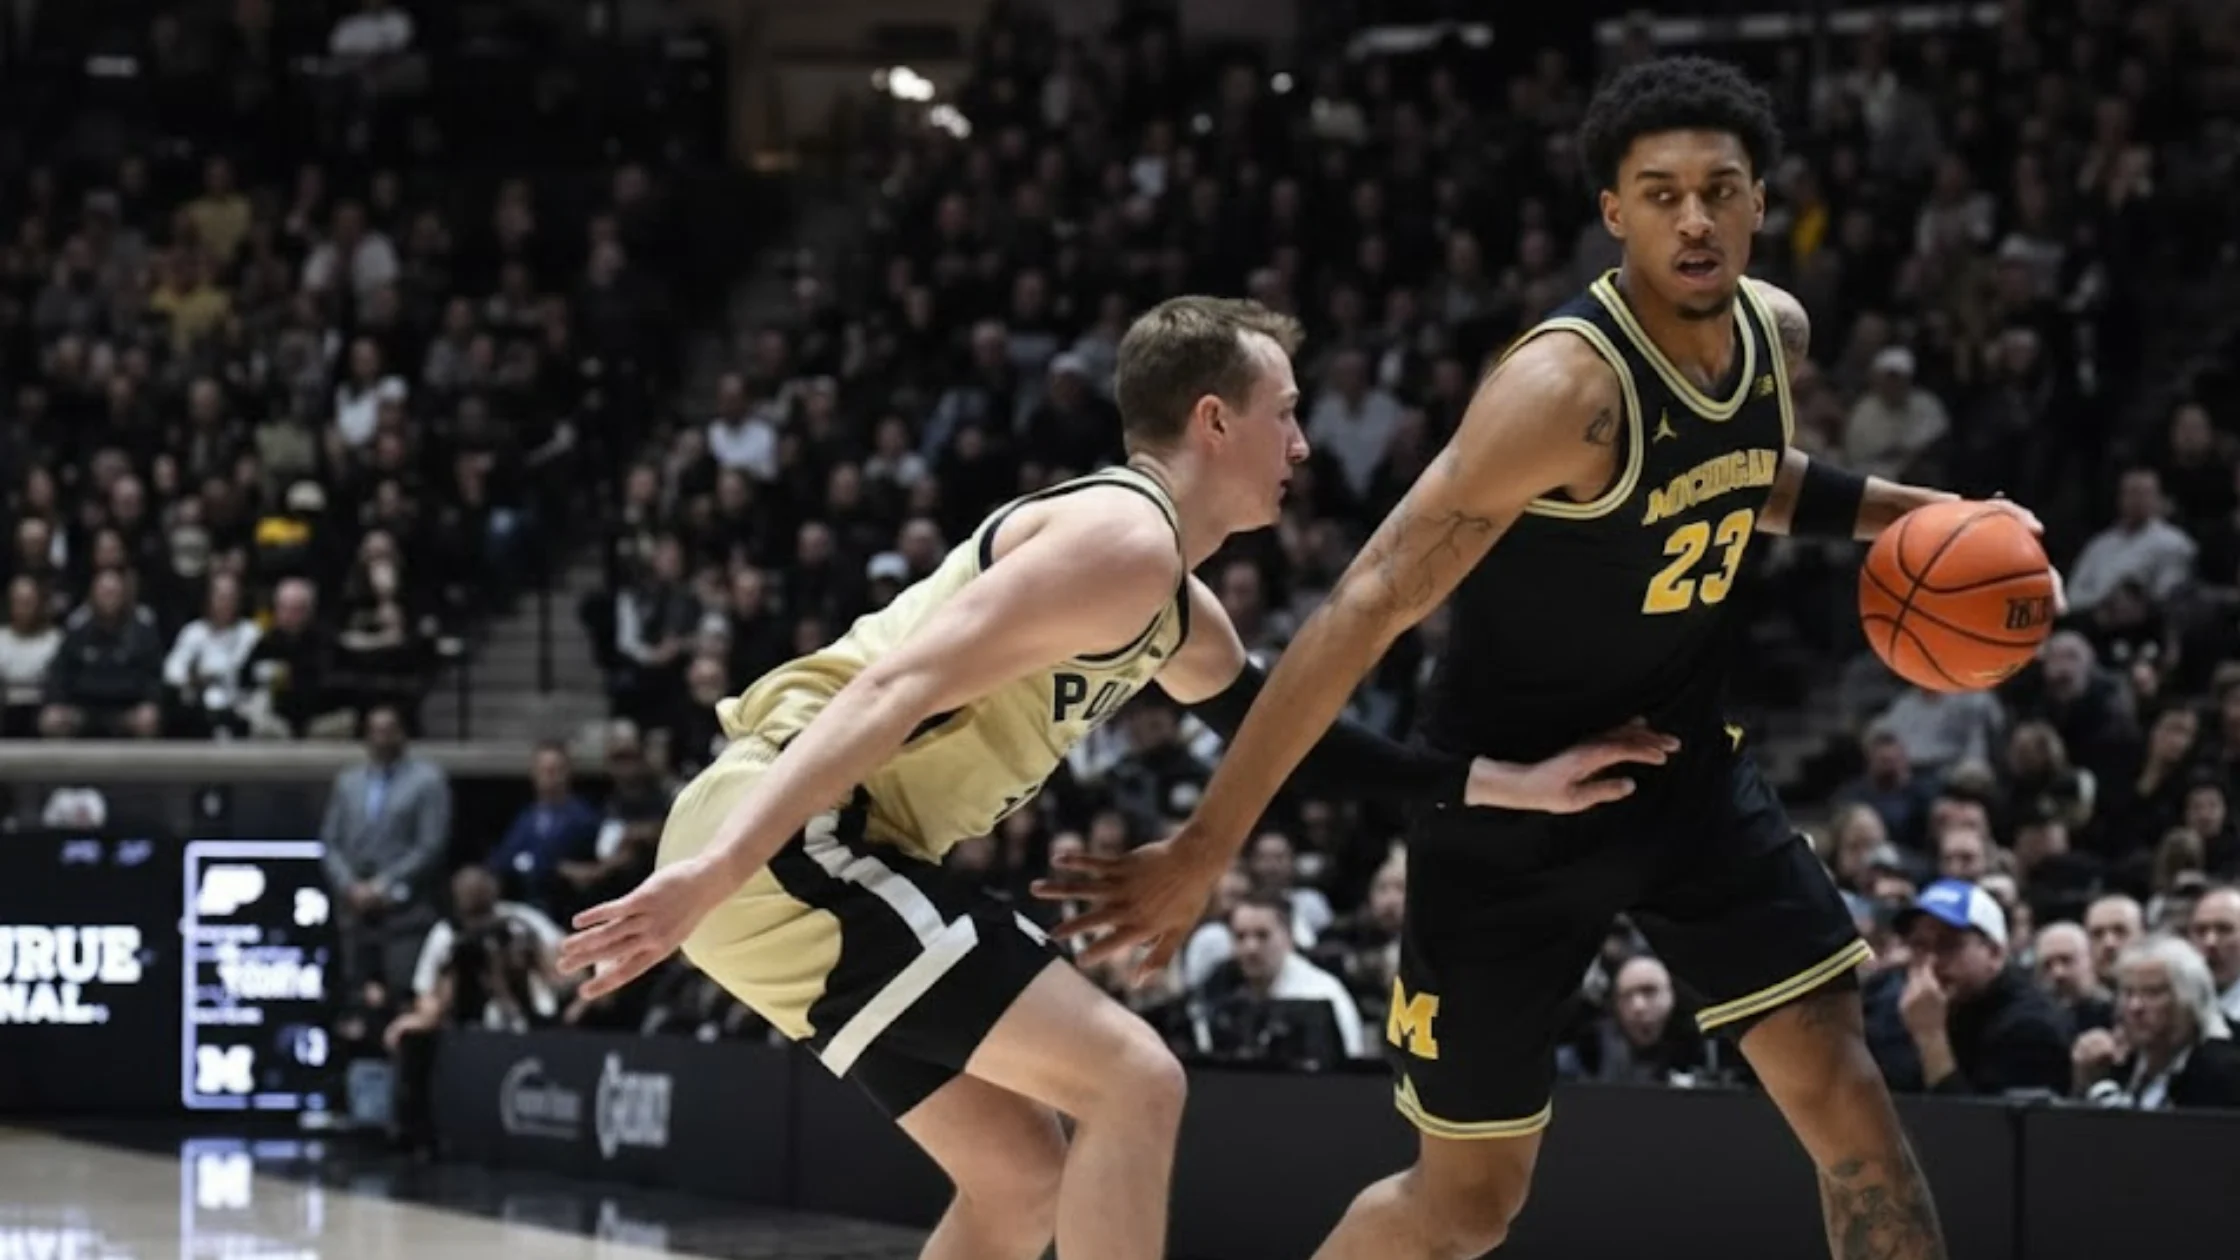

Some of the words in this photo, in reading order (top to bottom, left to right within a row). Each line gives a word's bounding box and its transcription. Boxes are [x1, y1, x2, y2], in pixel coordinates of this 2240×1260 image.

[1641, 449, 1778, 526] MICHIGAN
[1641, 508, 1754, 614] 23
[1386, 974, 1439, 1060] M
